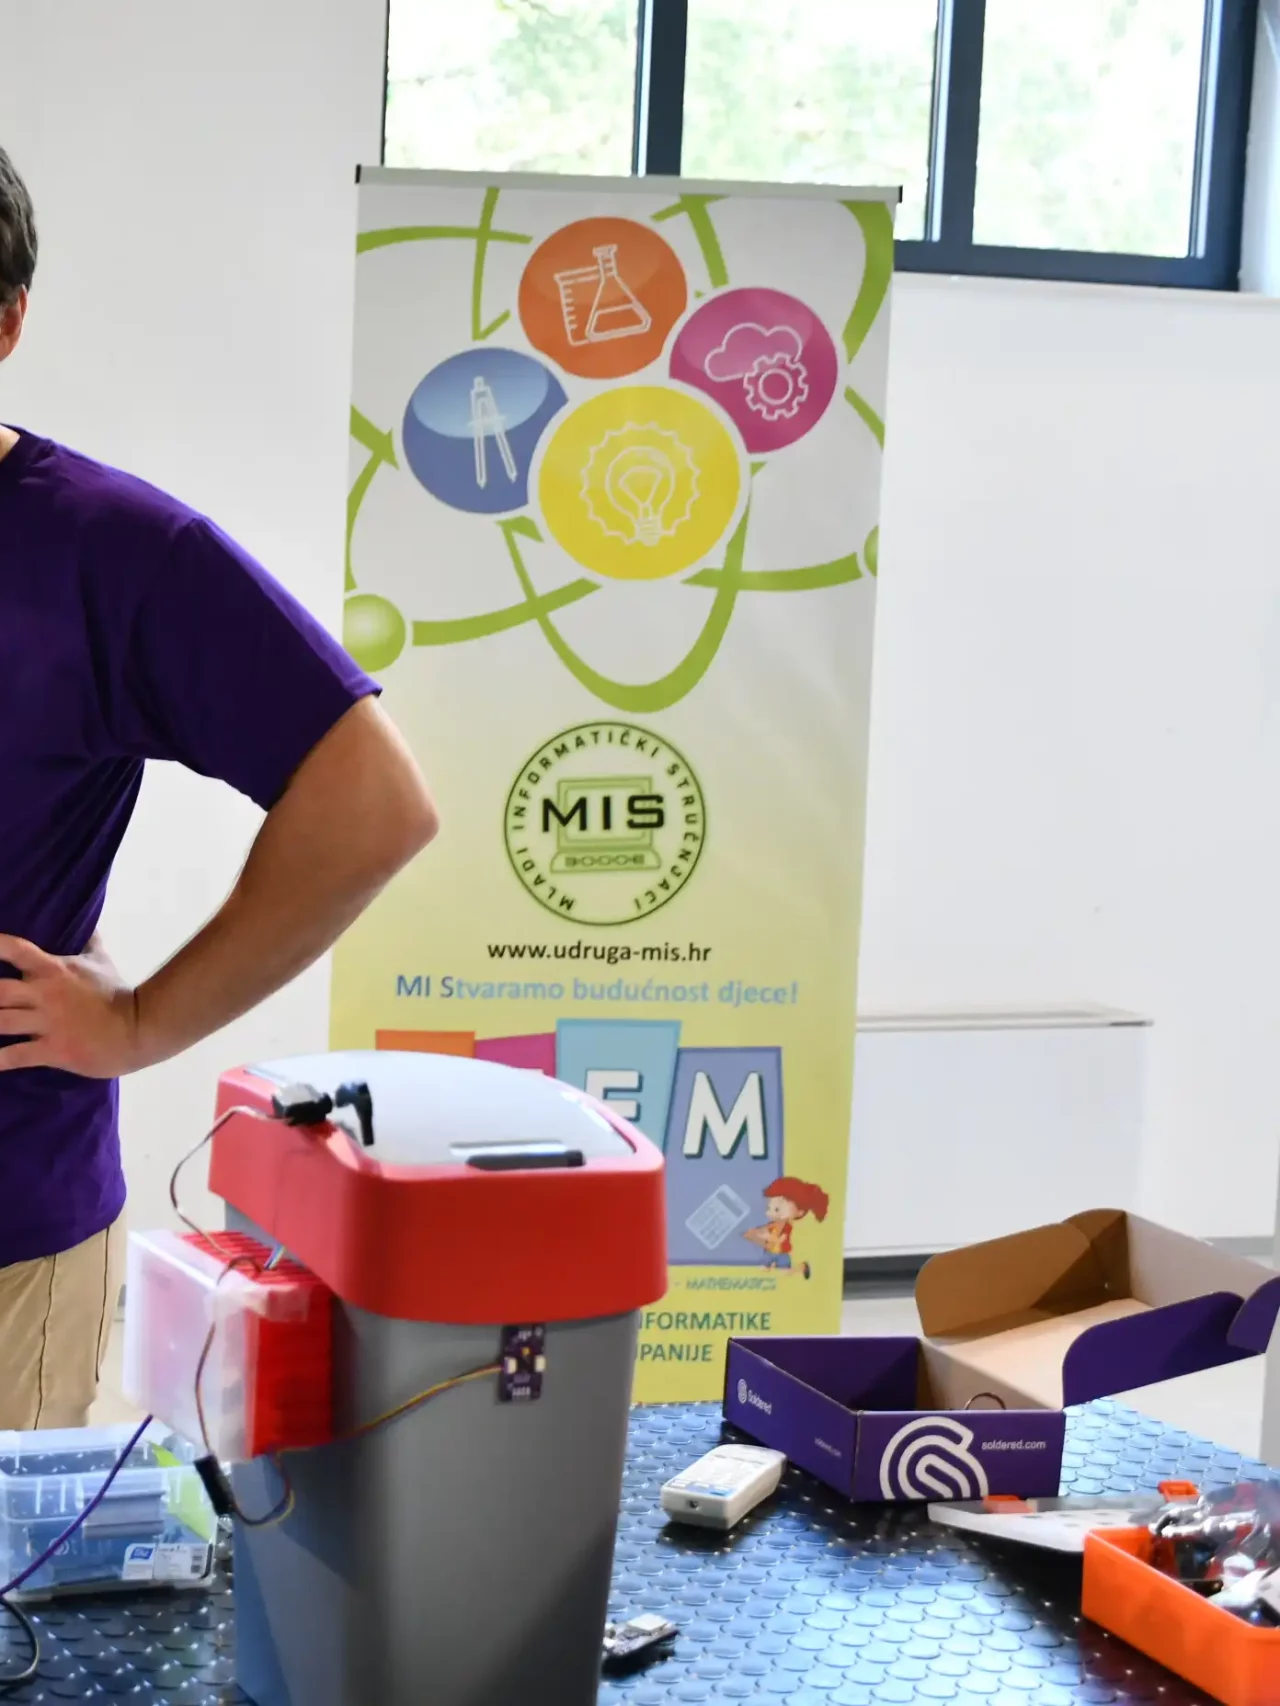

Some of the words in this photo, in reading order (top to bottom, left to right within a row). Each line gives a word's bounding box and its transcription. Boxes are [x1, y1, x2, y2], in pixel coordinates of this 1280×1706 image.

[512, 727, 659, 833] INFORMATIČKI
[541, 794, 665, 833] MIS
[632, 762, 701, 910] STRUČNJACI
[516, 846, 576, 911] MLADI
[487, 940, 712, 965] www.udruga-mis.hr
[396, 975, 431, 997] MI
[440, 976, 564, 1001] Stvaramo
[572, 977, 709, 1003] budućnost
[717, 980, 799, 1008] djece!
[584, 1068, 770, 1161] EM
[636, 1343, 714, 1362] PANIJE
[981, 1438, 1047, 1451] soldered.com
